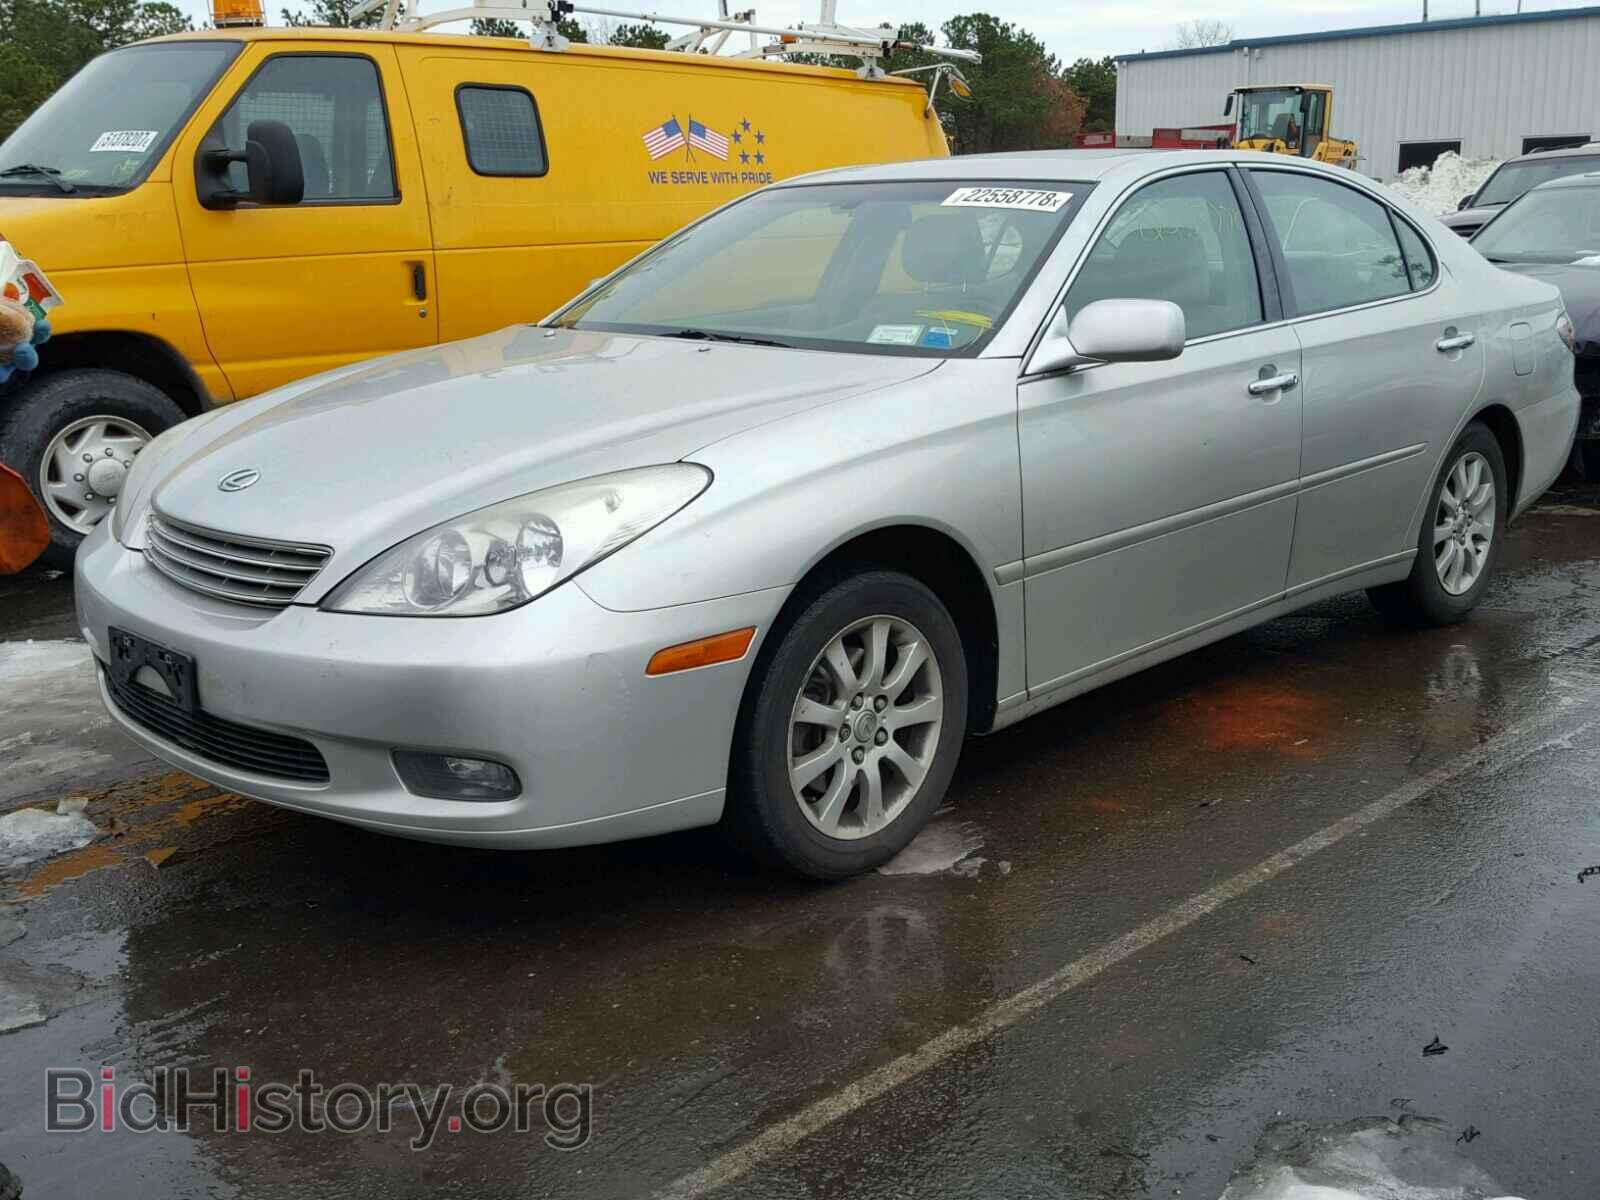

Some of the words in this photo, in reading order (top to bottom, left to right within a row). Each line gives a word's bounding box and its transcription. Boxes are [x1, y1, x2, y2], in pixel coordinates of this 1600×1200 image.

[648, 171, 668, 184] WE
[671, 171, 709, 184] SERVE
[710, 172, 738, 184] WITH
[741, 172, 773, 184] PRIDE
